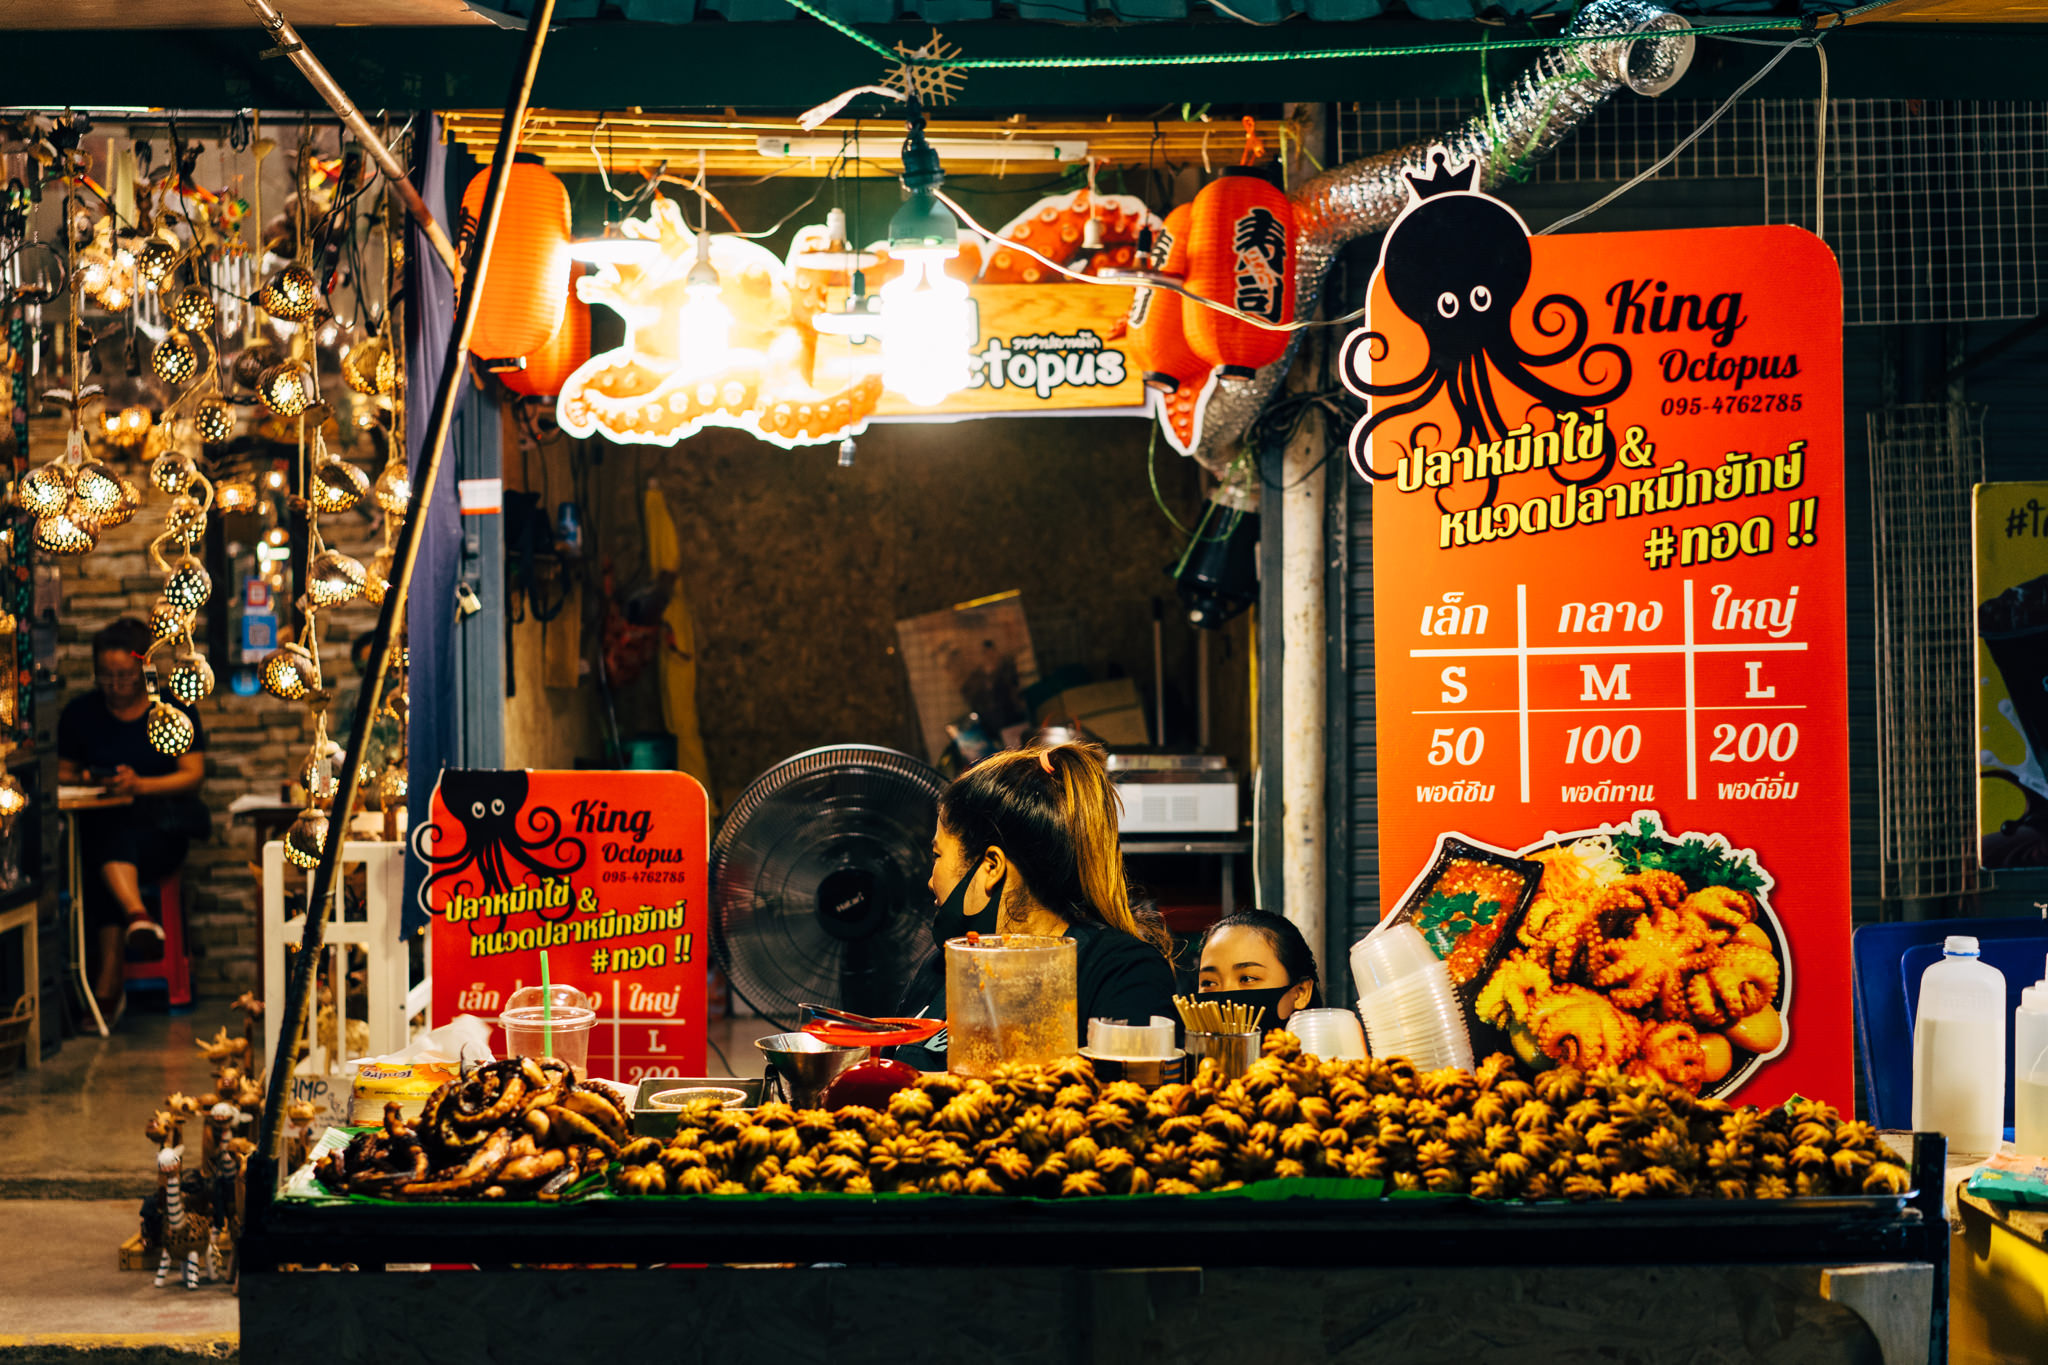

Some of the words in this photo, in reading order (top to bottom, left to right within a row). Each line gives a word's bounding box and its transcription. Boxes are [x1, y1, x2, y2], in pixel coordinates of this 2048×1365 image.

[1604, 279, 1748, 348] King
[967, 337, 1127, 399] ctopus
[1659, 348, 1801, 390] Octopus
[1661, 393, 1802, 416] 095-4762785
[1396, 409, 1608, 494] ปลาหมึกไข่
[1618, 426, 1655, 469] &
[1438, 441, 1808, 549] หนวดปลาหมึกยักษ์
[1643, 516, 1774, 570] #ทอด
[1787, 497, 1819, 548] !!
[1420, 591, 1489, 636] เล็ก
[1558, 601, 1663, 633] กลาง
[1711, 584, 1799, 638] ใหญ่
[1440, 665, 1468, 704] S
[1579, 663, 1631, 701] M
[1745, 661, 1775, 698] L
[1427, 726, 1485, 766] 50
[1565, 724, 1641, 764] 100
[1709, 722, 1799, 763] 200
[1561, 779, 1654, 803] พอดีทาน
[1718, 771, 1799, 800] พอดีอิ่ม
[571, 800, 654, 843] King
[602, 842, 683, 869] Octopus
[602, 871, 685, 884] 095-4762785
[445, 876, 571, 923] ปลาหมึกไข่
[577, 887, 598, 913] &
[470, 899, 687, 958] หนวดปลาหมึกยักษ์
[591, 942, 666, 974] #ทอด
[457, 981, 500, 1011] เล็ก
[628, 985, 682, 1017] ใหญ่
[647, 1029, 667, 1053] L
